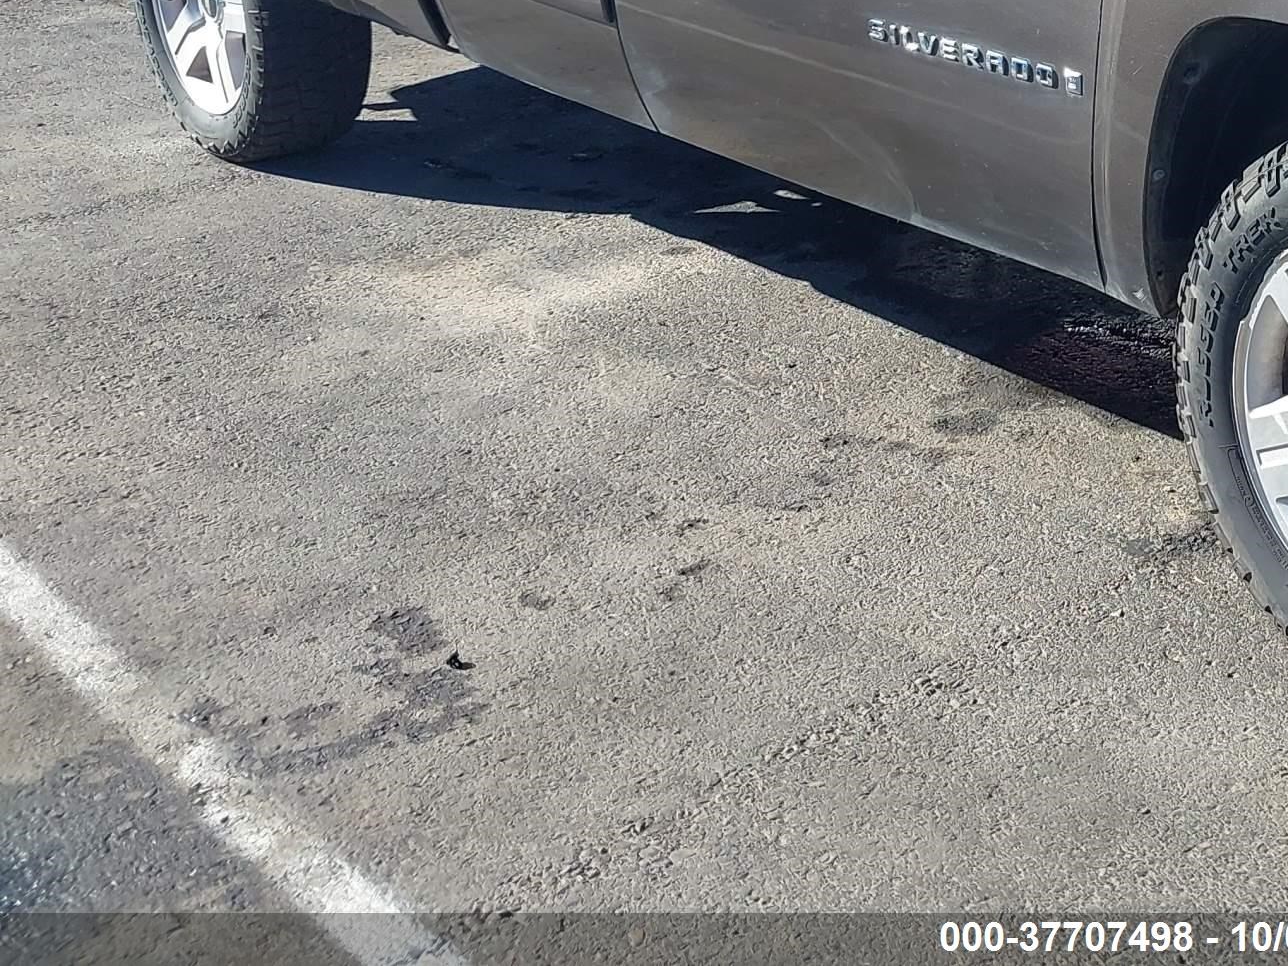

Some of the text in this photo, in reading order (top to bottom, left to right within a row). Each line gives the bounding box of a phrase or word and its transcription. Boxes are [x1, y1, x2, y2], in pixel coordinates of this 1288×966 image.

[867, 17, 1059, 90] SILVERADO
[1196, 206, 1285, 428] RUGGED TREK
